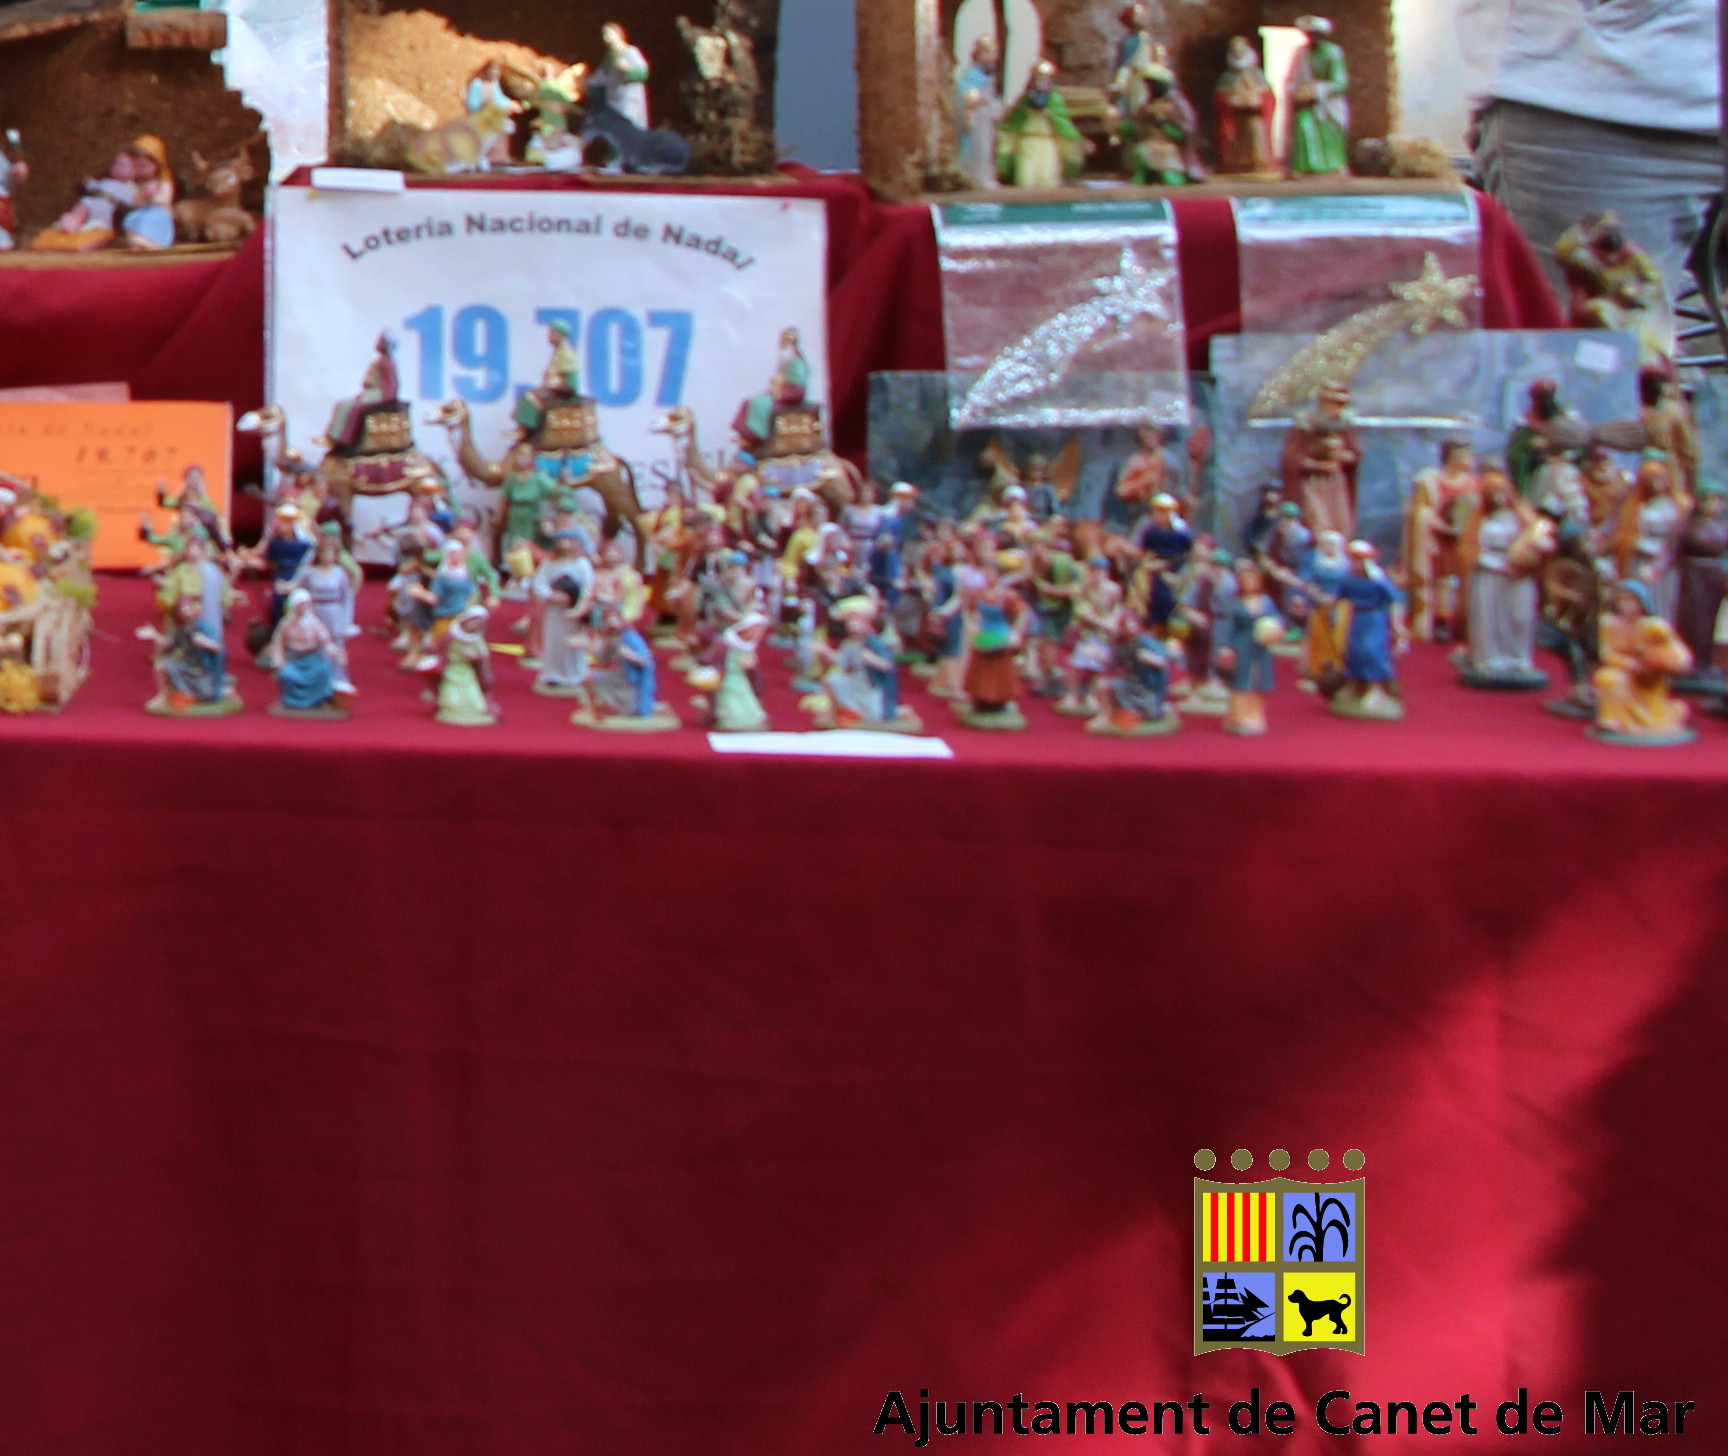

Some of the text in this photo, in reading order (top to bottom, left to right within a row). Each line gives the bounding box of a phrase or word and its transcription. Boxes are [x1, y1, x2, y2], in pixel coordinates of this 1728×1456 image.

[464, 211, 602, 234] Nacional
[612, 217, 650, 239] de
[661, 222, 755, 271] Nadal
